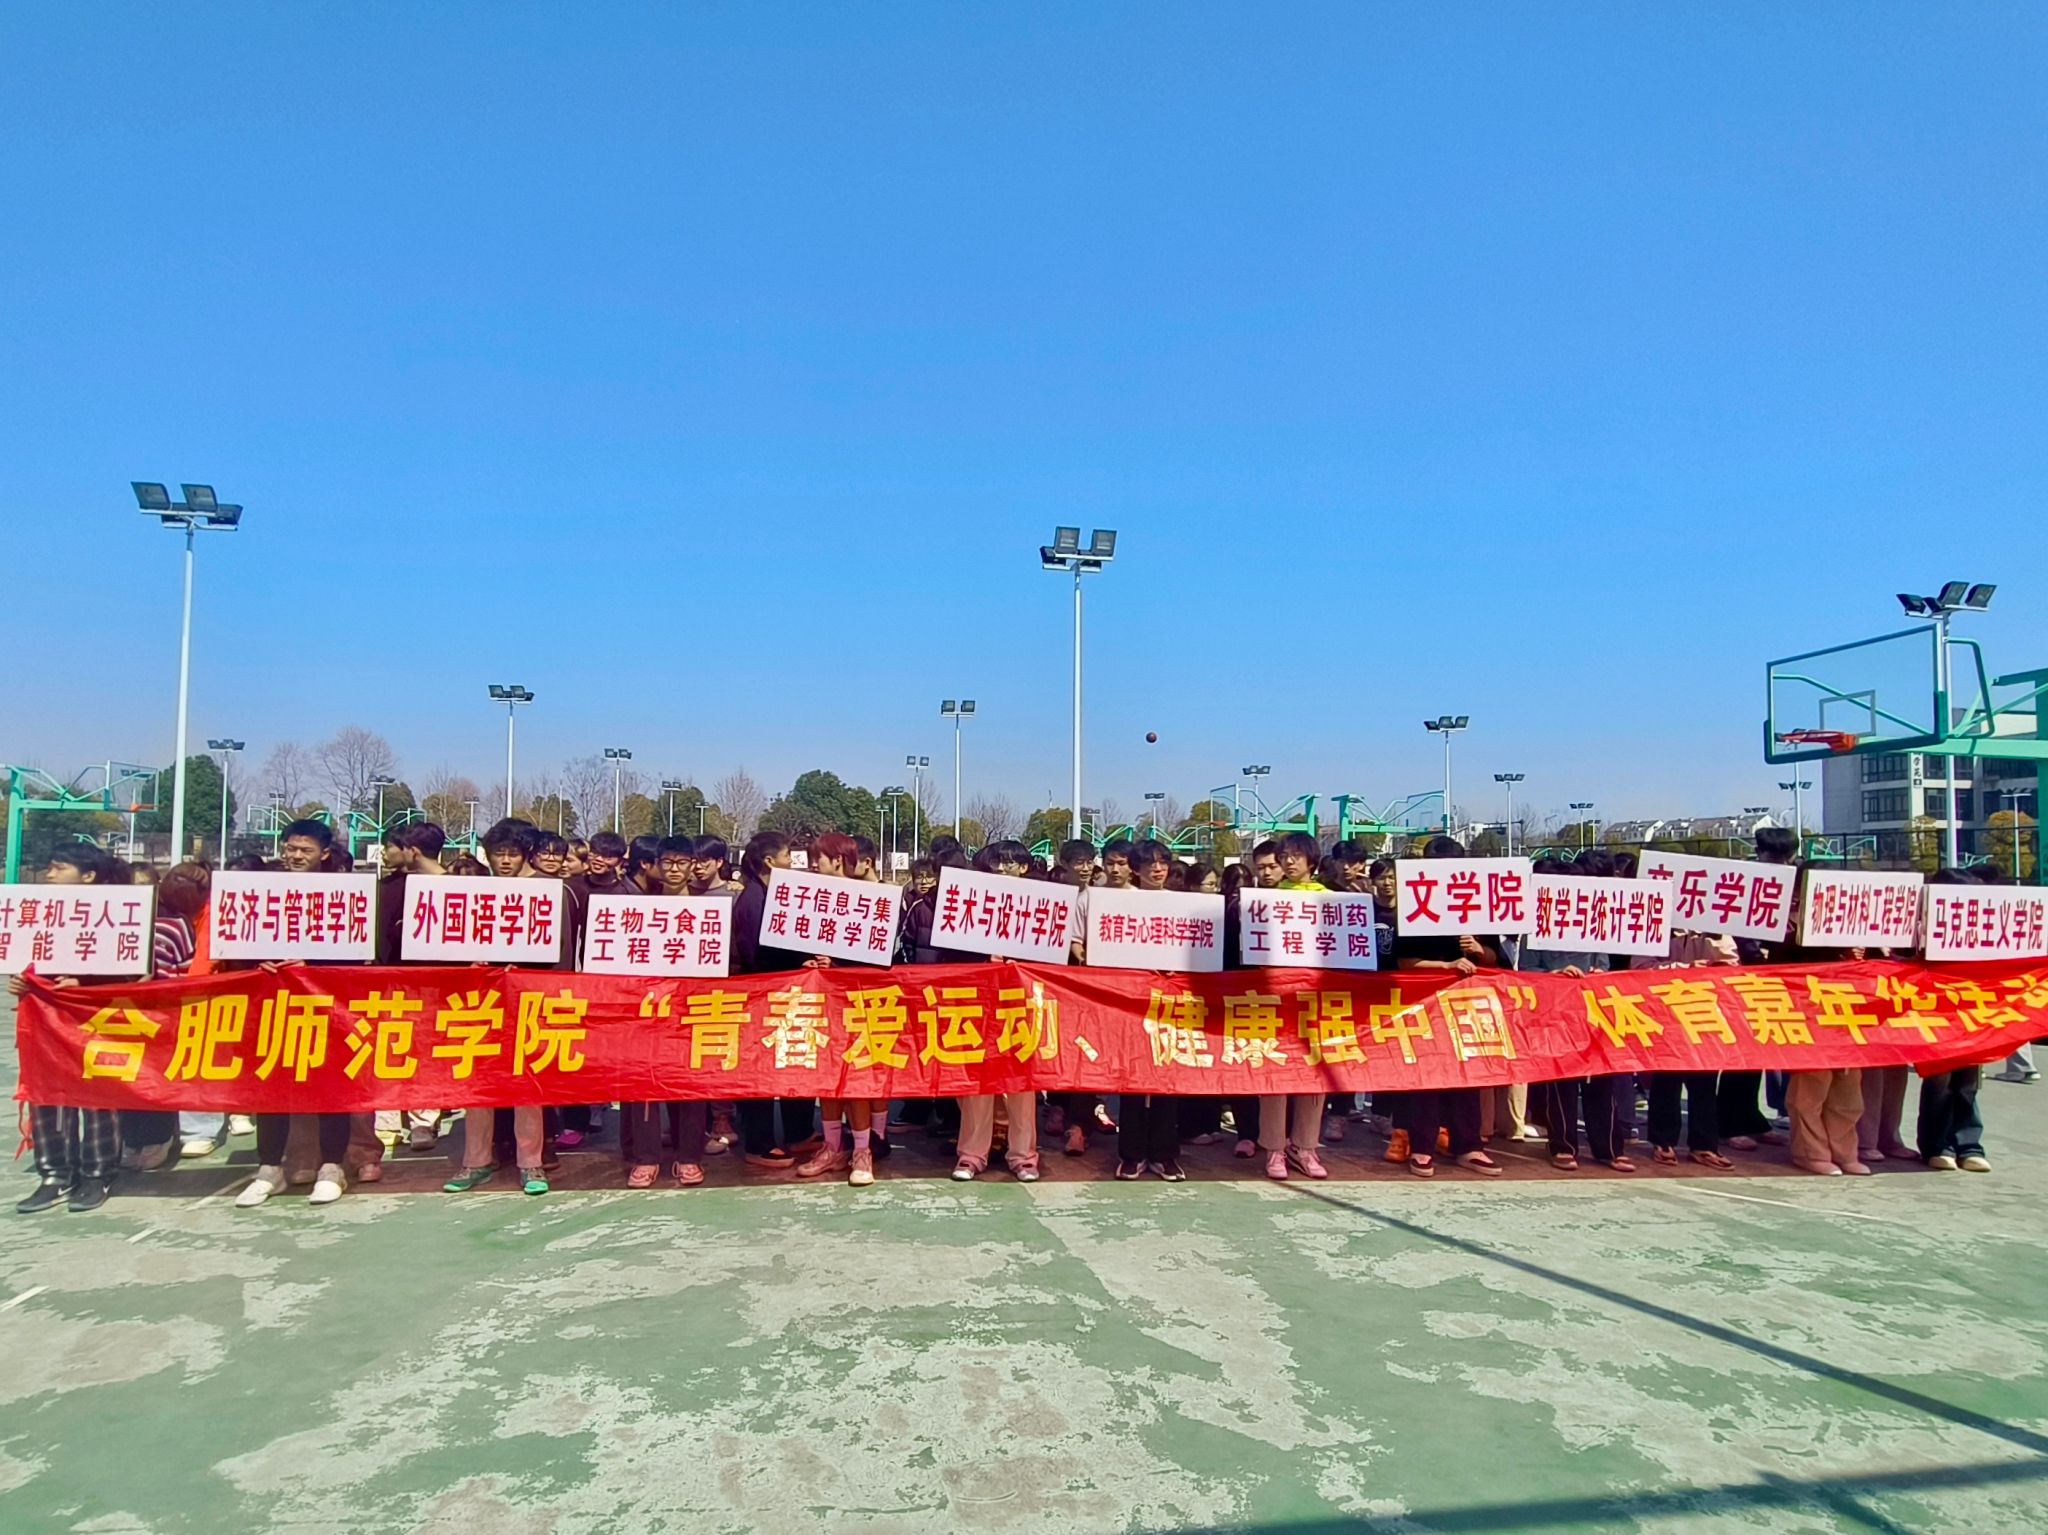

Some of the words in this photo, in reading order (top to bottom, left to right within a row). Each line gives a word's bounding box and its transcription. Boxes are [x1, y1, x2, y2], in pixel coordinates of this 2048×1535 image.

[217, 889, 368, 943] 经济与管理学院
[412, 891, 554, 945] 外国语学院
[594, 906, 722, 936] 生物与食品
[775, 882, 892, 923] 电子信息与集
[940, 884, 1069, 949] 美术与设计学院
[1247, 899, 1369, 929] 化学与制药
[1404, 871, 1525, 924] 文学院
[1535, 886, 1664, 945] 数学与统计学院
[1811, 882, 1917, 936] 物理与材料工程学院
[768, 910, 889, 952] 成电路学院
[1099, 913, 1214, 948] 教育与心理科学学院
[1250, 930, 1371, 958] 工程学院
[1932, 896, 2045, 952] 马克思主义学院
[592, 937, 722, 966] 工程学院
